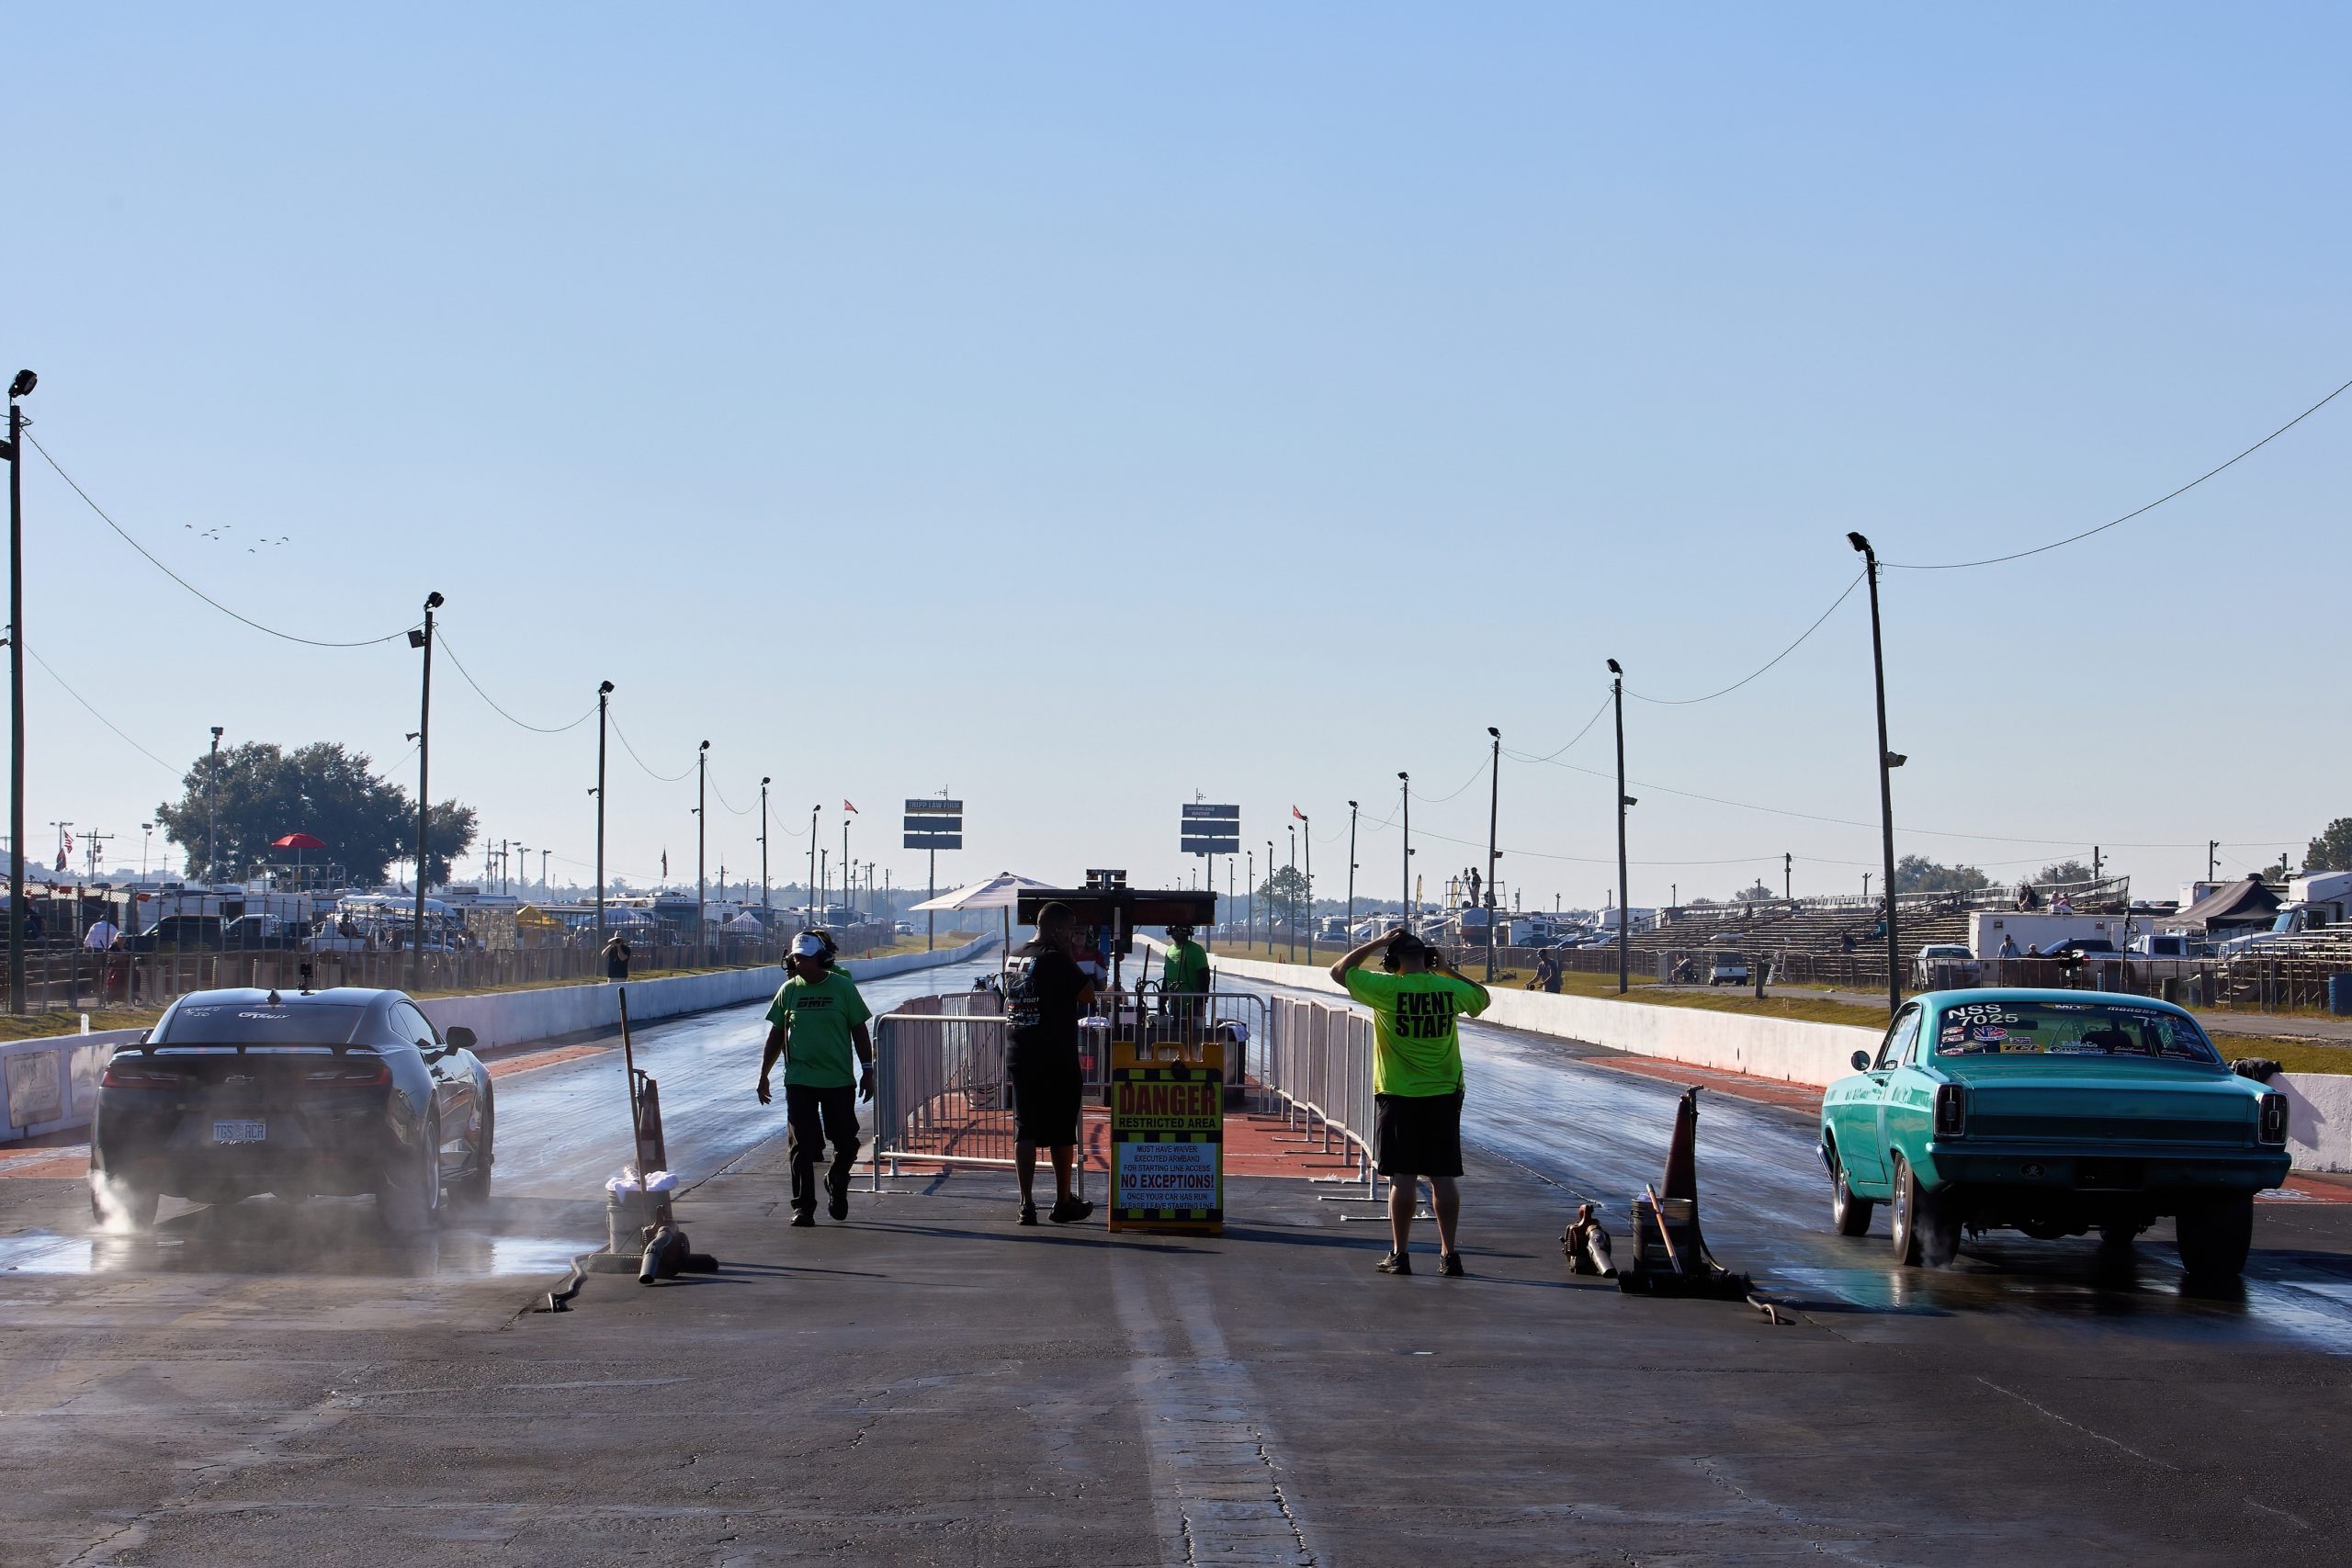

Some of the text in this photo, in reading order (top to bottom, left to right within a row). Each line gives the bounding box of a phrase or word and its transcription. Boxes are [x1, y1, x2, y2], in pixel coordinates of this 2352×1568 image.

[1396, 991, 1453, 1015] EVENT
[1948, 1003, 2002, 1020] NSS
[1958, 1013, 2019, 1027] 7025
[1119, 1085, 1216, 1116] DANGER
[1119, 1117, 1216, 1128] RESTRICTED AREA
[214, 1124, 233, 1139] TGS
[1121, 1174, 1214, 1188] NO EXCEPTIONS!
